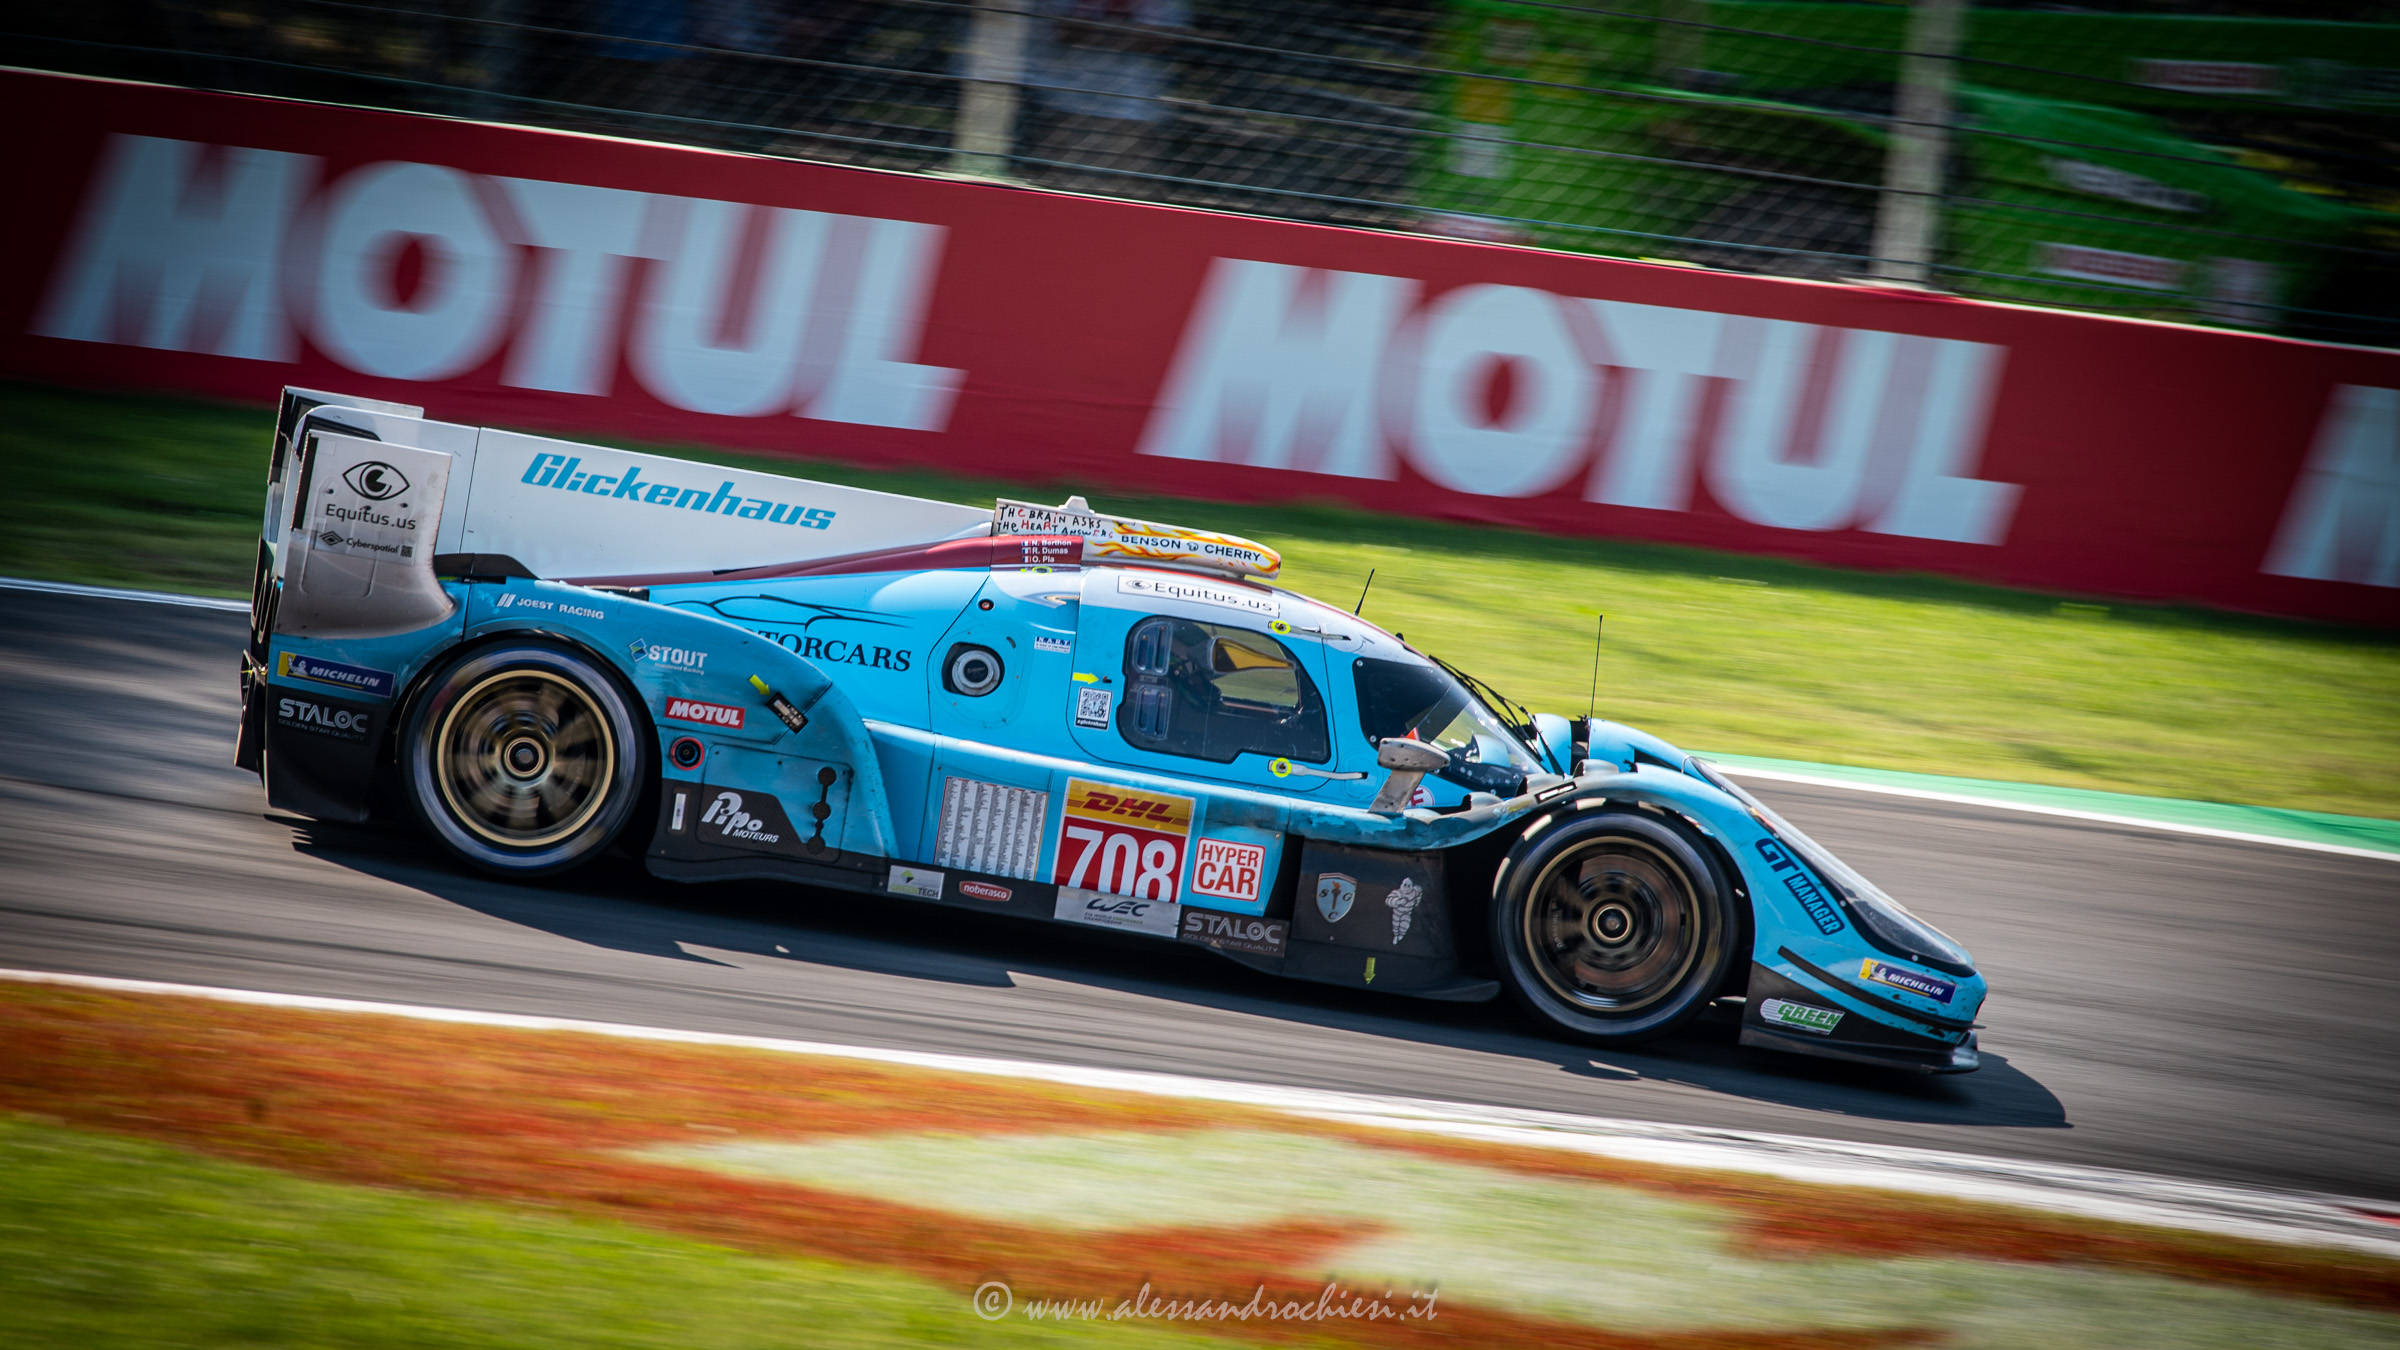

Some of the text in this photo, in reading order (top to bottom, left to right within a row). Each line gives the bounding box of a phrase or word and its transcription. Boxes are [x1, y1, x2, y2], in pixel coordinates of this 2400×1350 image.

[32, 133, 966, 432] MOTUL
[1138, 257, 2022, 546] MOTUL
[521, 453, 836, 530] Glickenhaus
[325, 503, 416, 530] Equitus.us
[1021, 520, 1058, 533] HEART
[1073, 516, 1101, 529] ASKS
[346, 537, 399, 554] Cyberspatial
[1121, 535, 1261, 561] BENSON CHERRY
[516, 597, 605, 620] JOEST RACING
[1155, 582, 1272, 611] Equitus.us
[648, 645, 708, 668] STOUT
[749, 629, 911, 672] TORCARS
[310, 666, 380, 688] MICHELIN
[279, 698, 368, 733] STALOC
[668, 701, 740, 726] MOTUL
[701, 792, 763, 835] Pipo
[1082, 791, 1174, 823] DHL
[732, 829, 779, 843] MOTEURS
[1066, 825, 1176, 903] 708
[1200, 842, 1259, 868] HYPER
[1754, 838, 1800, 872] GT
[963, 883, 1007, 899] noberasco
[1198, 861, 1256, 897] CAR
[1086, 898, 1150, 917] WEC
[1788, 875, 1842, 934] MANAGER
[1184, 912, 1282, 944] STALOC
[1243, 942, 1279, 953] QUALITY
[1887, 973, 1944, 996] MICHELIN
[1777, 1004, 1841, 1026] GREEN
